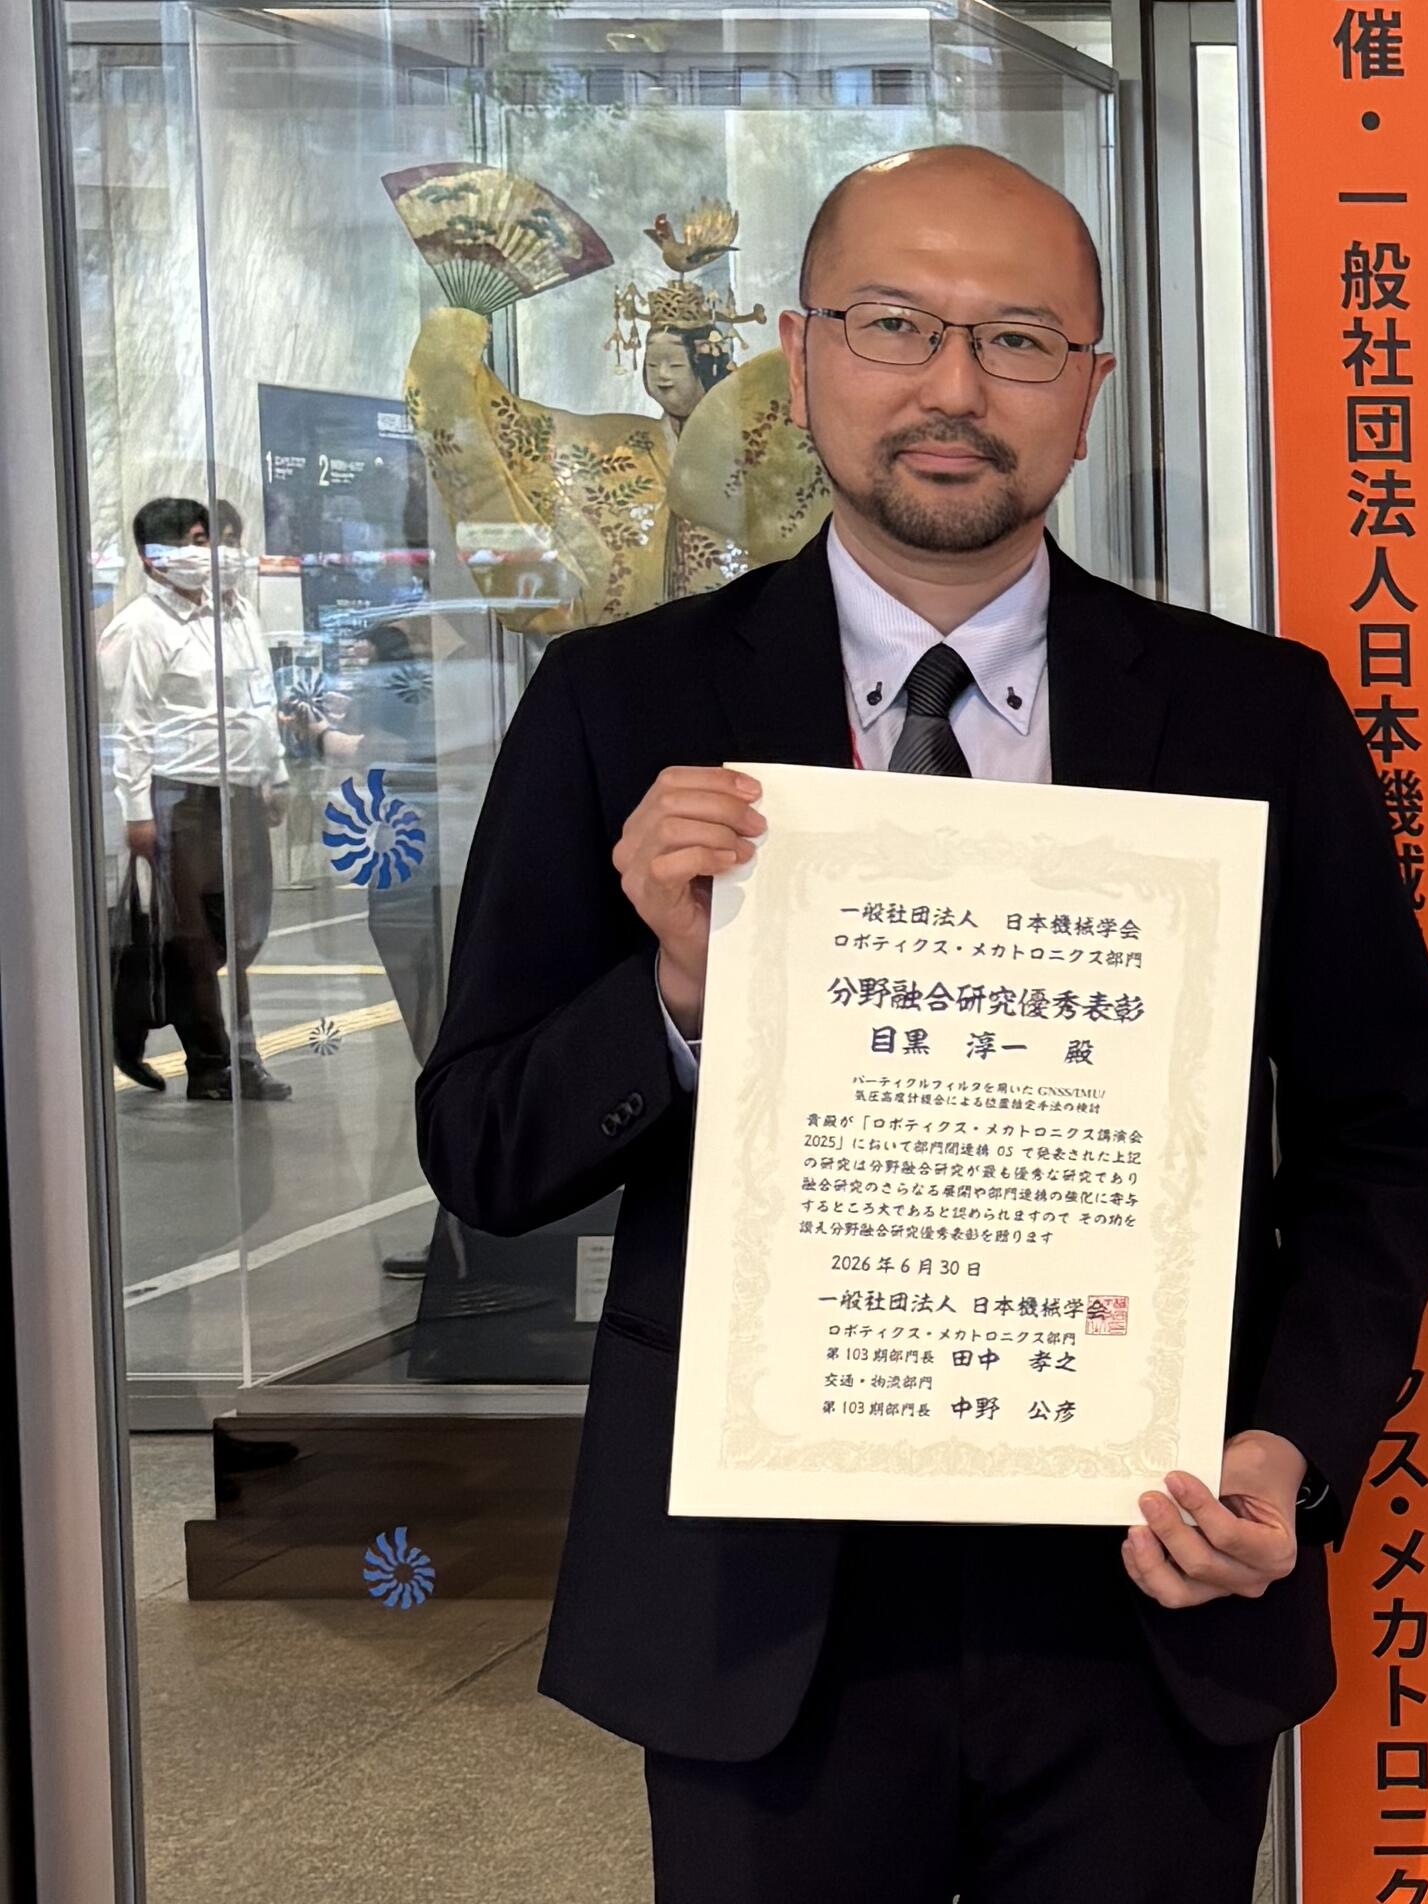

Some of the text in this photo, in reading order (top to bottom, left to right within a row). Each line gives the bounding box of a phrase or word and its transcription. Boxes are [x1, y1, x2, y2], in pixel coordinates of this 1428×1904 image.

[319, 454, 329, 486] 2
[841, 902, 1141, 941] 一般社団法人 日本機械学会
[834, 934, 1142, 968] ロボティクス・メカトロニクス部門
[827, 976, 1145, 1023] 分野融合研究優秀表彰
[871, 1025, 1094, 1065] 目黒 淳一 殿
[817, 1289, 957, 1314] 一般社団法人
[972, 1295, 1108, 1321] 日本機械学会
[828, 1324, 1077, 1346] ロボティクス・メカトロニクス部門
[952, 1348, 1001, 1371] 田中
[1028, 1350, 1077, 1373] 孝之
[824, 1373, 933, 1391] 交通・物流部門
[951, 1395, 1001, 1420] 中野
[1027, 1399, 1077, 1424] 公彦
